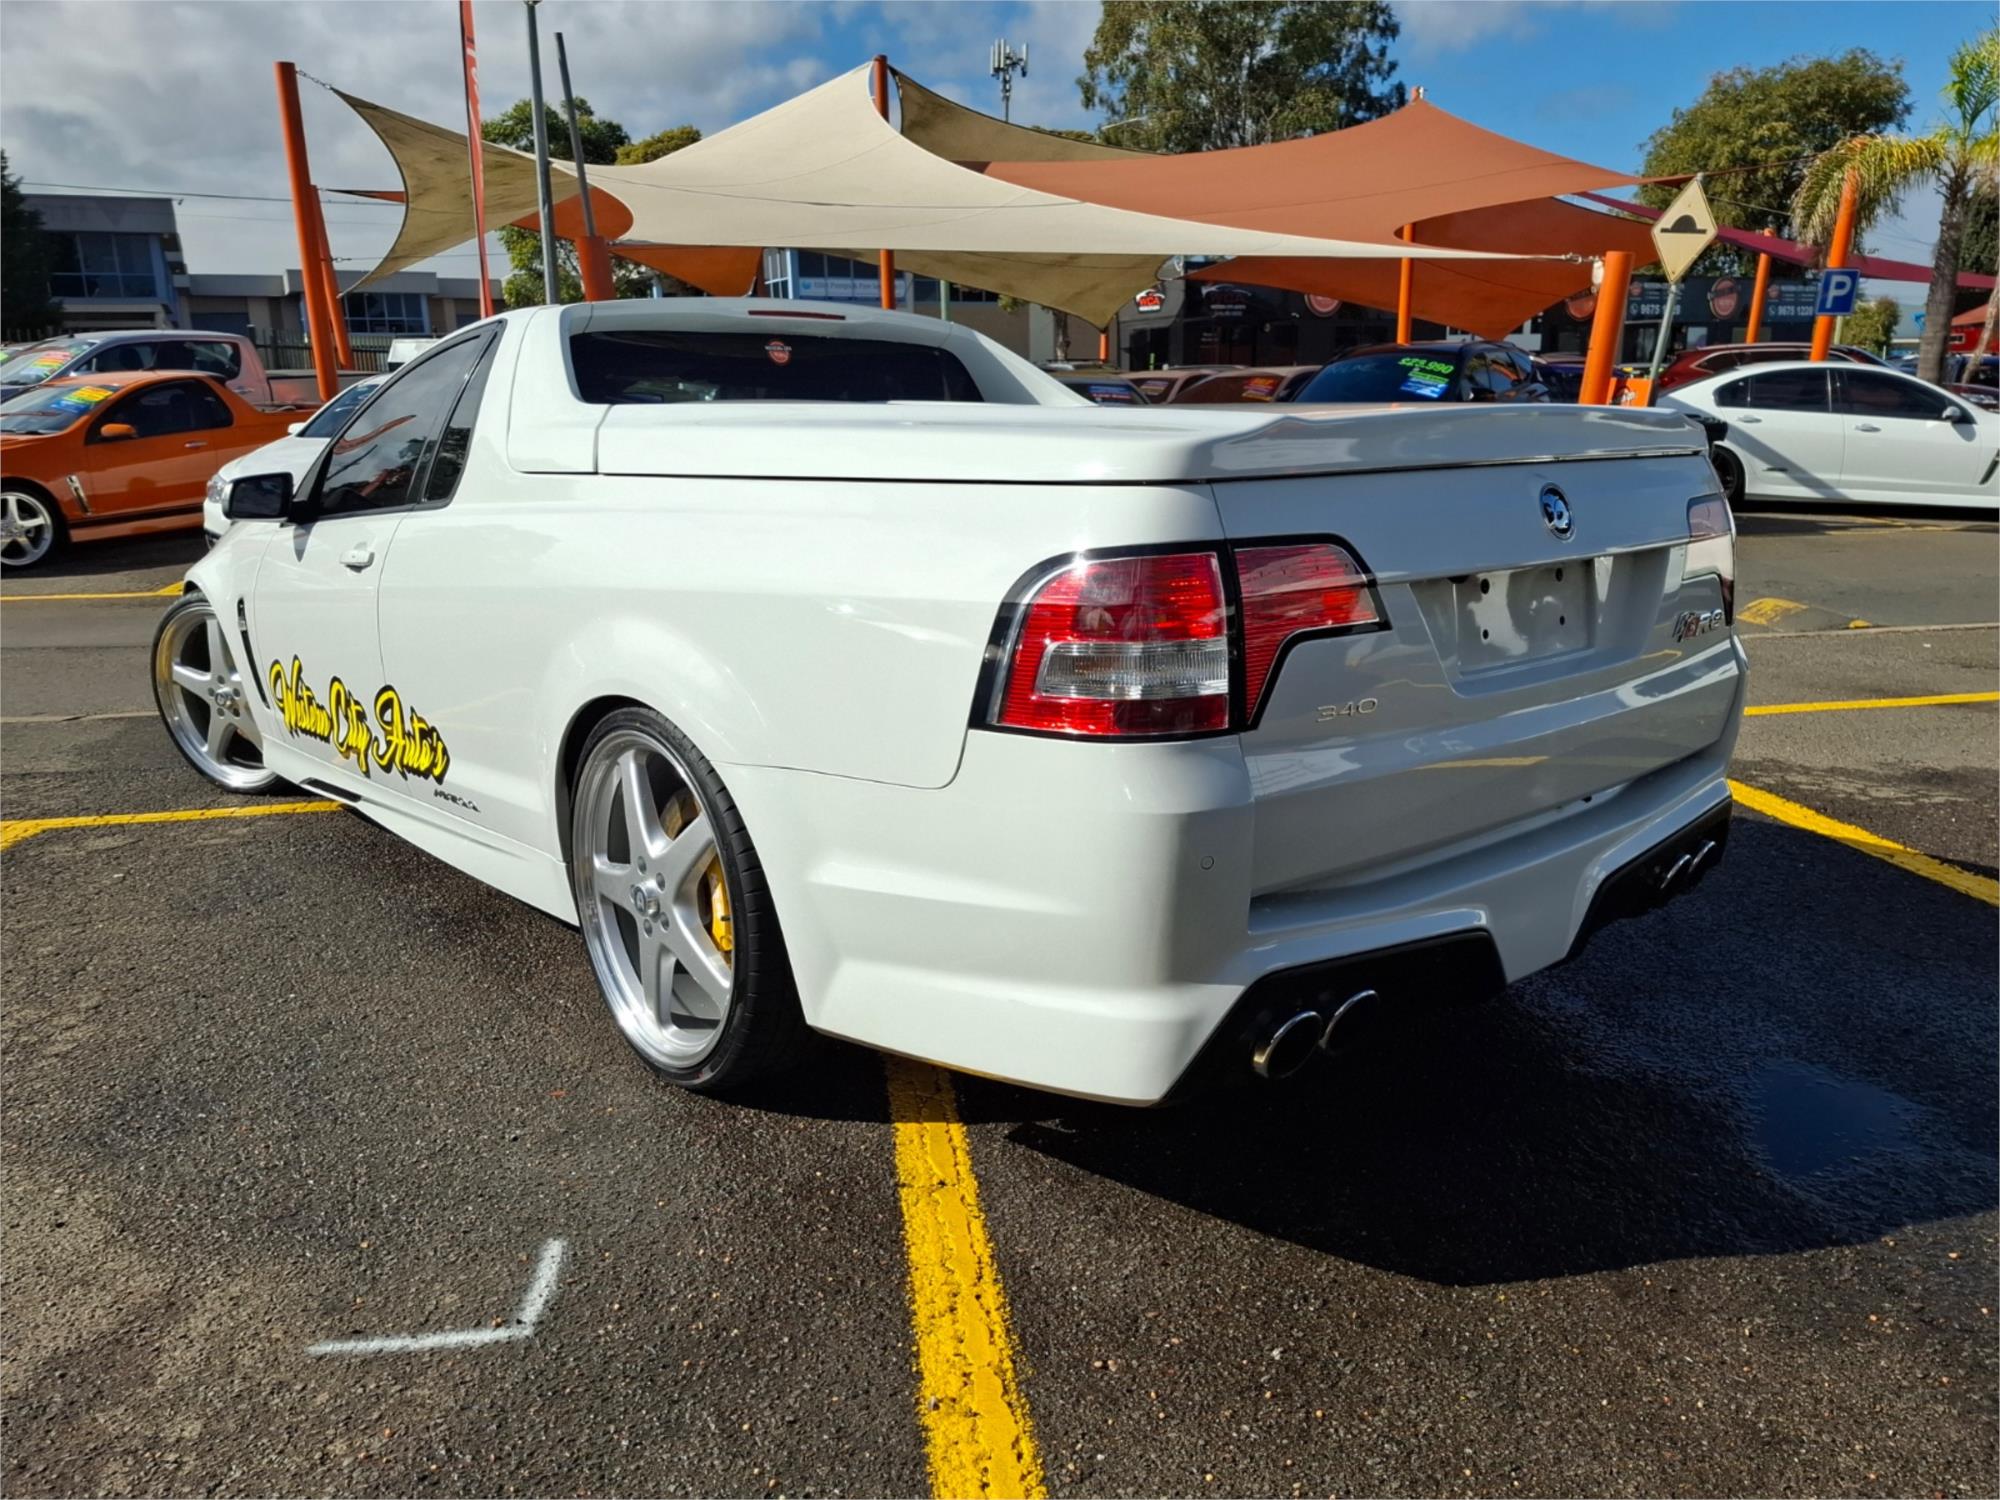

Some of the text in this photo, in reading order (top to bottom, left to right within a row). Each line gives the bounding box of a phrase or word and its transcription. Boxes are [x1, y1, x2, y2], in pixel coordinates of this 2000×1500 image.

[1138, 295, 1160, 306] WCA
[1825, 275, 1852, 309] P
[1317, 697, 1378, 722] 340
[329, 676, 372, 779] City
[371, 685, 450, 785] Auto's
